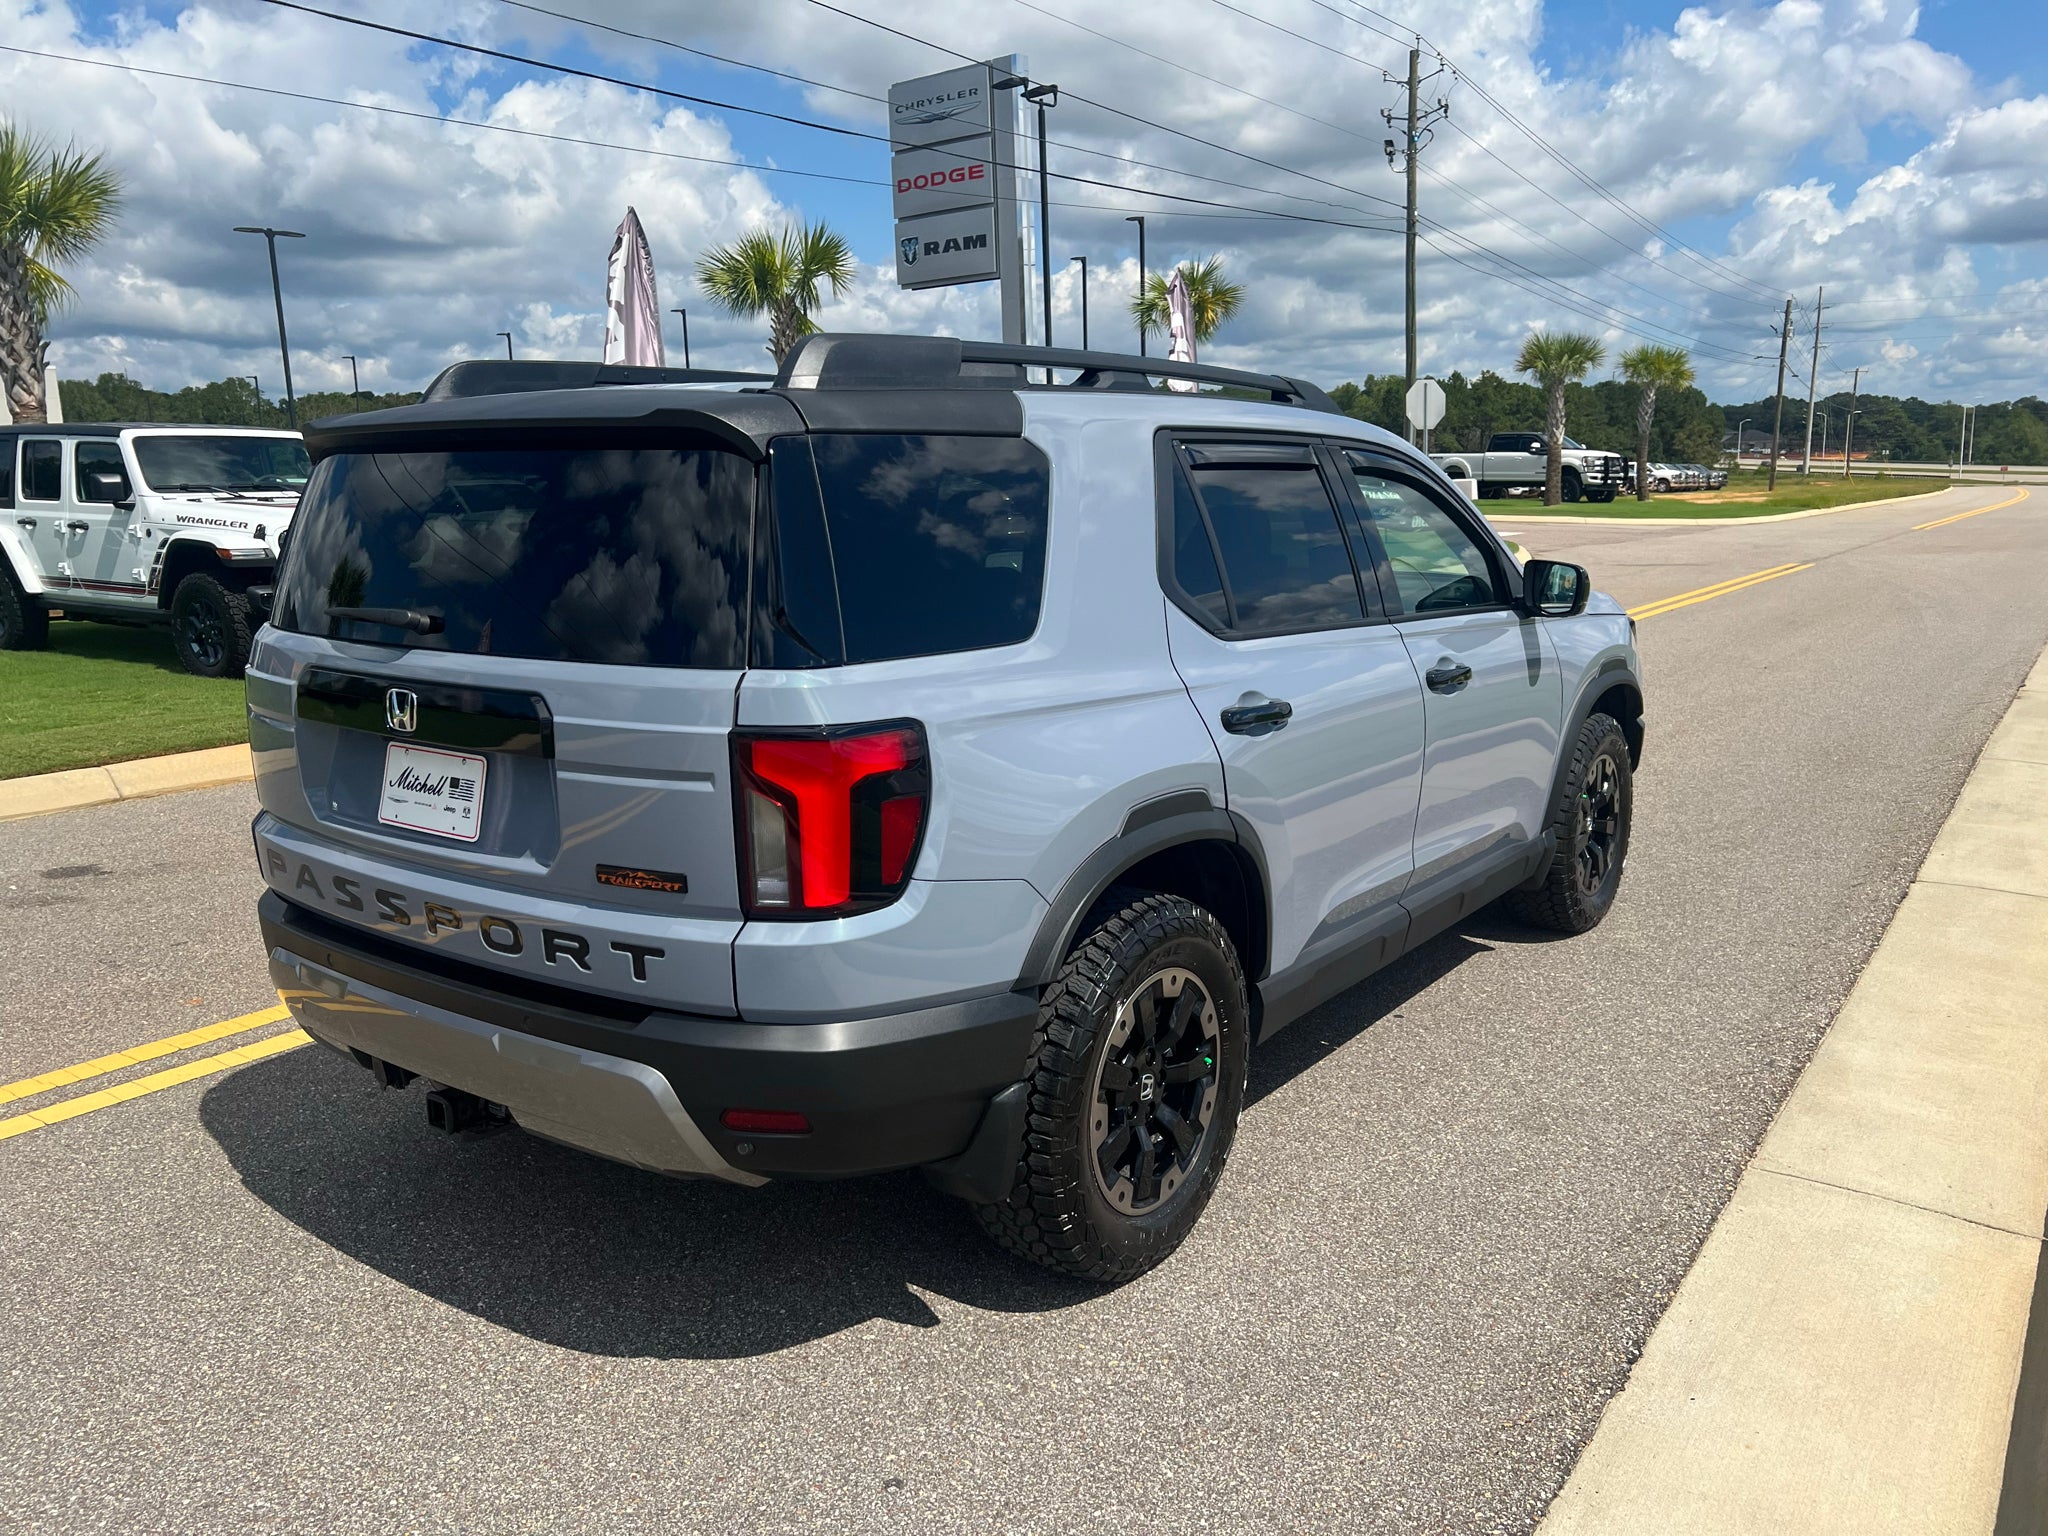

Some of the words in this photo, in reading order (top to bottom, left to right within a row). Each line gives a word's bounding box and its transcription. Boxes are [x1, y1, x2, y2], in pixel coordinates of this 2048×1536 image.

[895, 87, 979, 115] CHRYSLER
[897, 163, 985, 194] DODGE
[923, 233, 987, 256] RAM
[176, 514, 249, 529] WRANGLER
[389, 766, 449, 797] Mitchell
[597, 874, 684, 892] TRAILSPORT
[266, 847, 666, 983] PASSPORT
